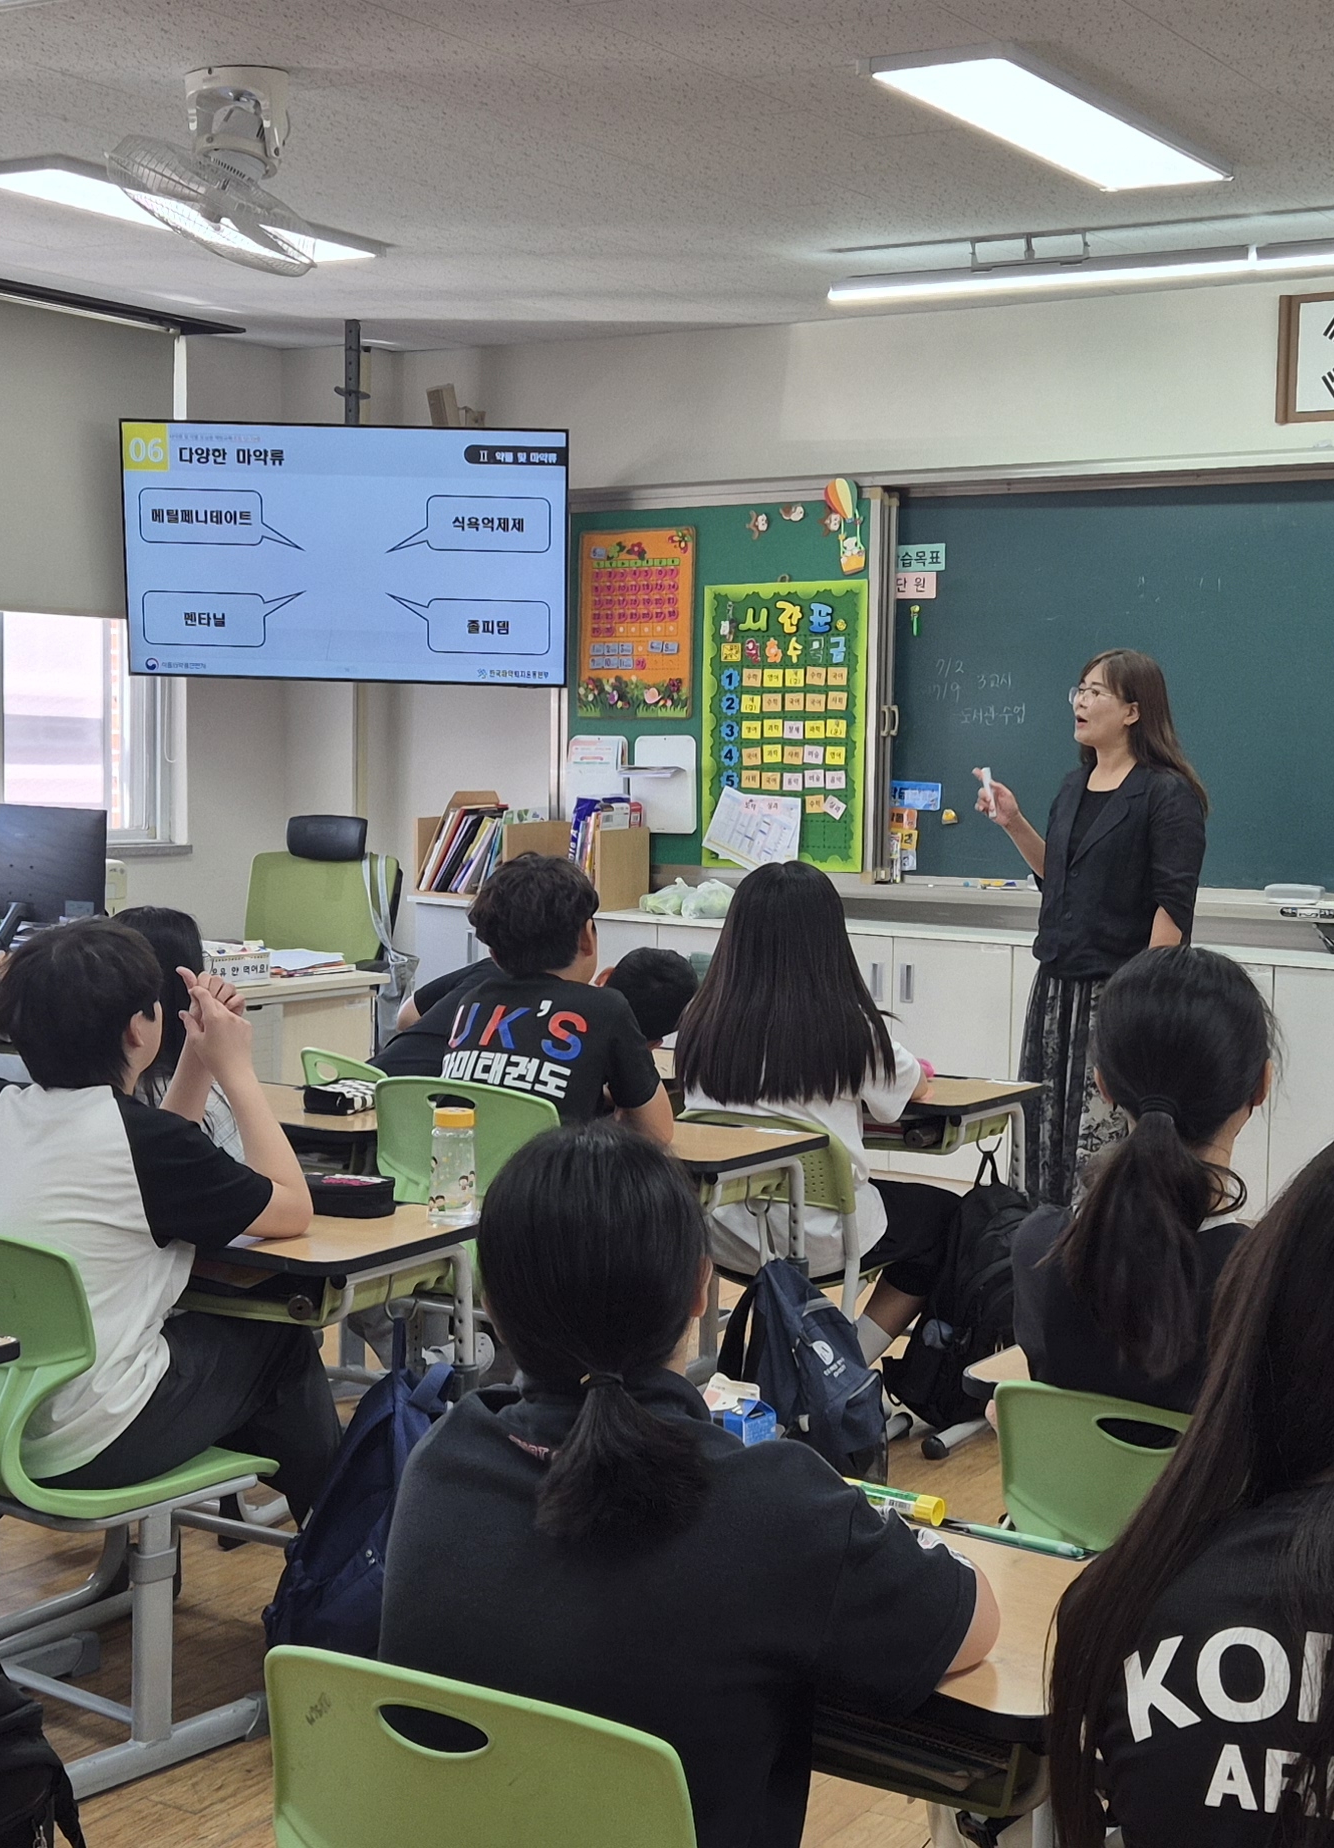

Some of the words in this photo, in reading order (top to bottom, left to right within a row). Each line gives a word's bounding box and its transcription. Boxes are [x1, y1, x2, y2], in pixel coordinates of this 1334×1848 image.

[129, 437, 163, 462] 06
[179, 447, 227, 465] 다양한
[237, 448, 285, 466] 마약류
[530, 452, 557, 463] 마약류
[452, 516, 525, 533] 식욕억제제
[897, 551, 942, 568] 습목표
[467, 619, 509, 635] 졸피뎀
[830, 636, 846, 663] 금
[726, 673, 733, 686] 1
[726, 698, 735, 710] 2
[725, 725, 734, 737] 3
[724, 749, 733, 761] 4
[726, 775, 734, 787] 5
[231, 966, 239, 976] 안
[448, 1000, 588, 1061] UK'S
